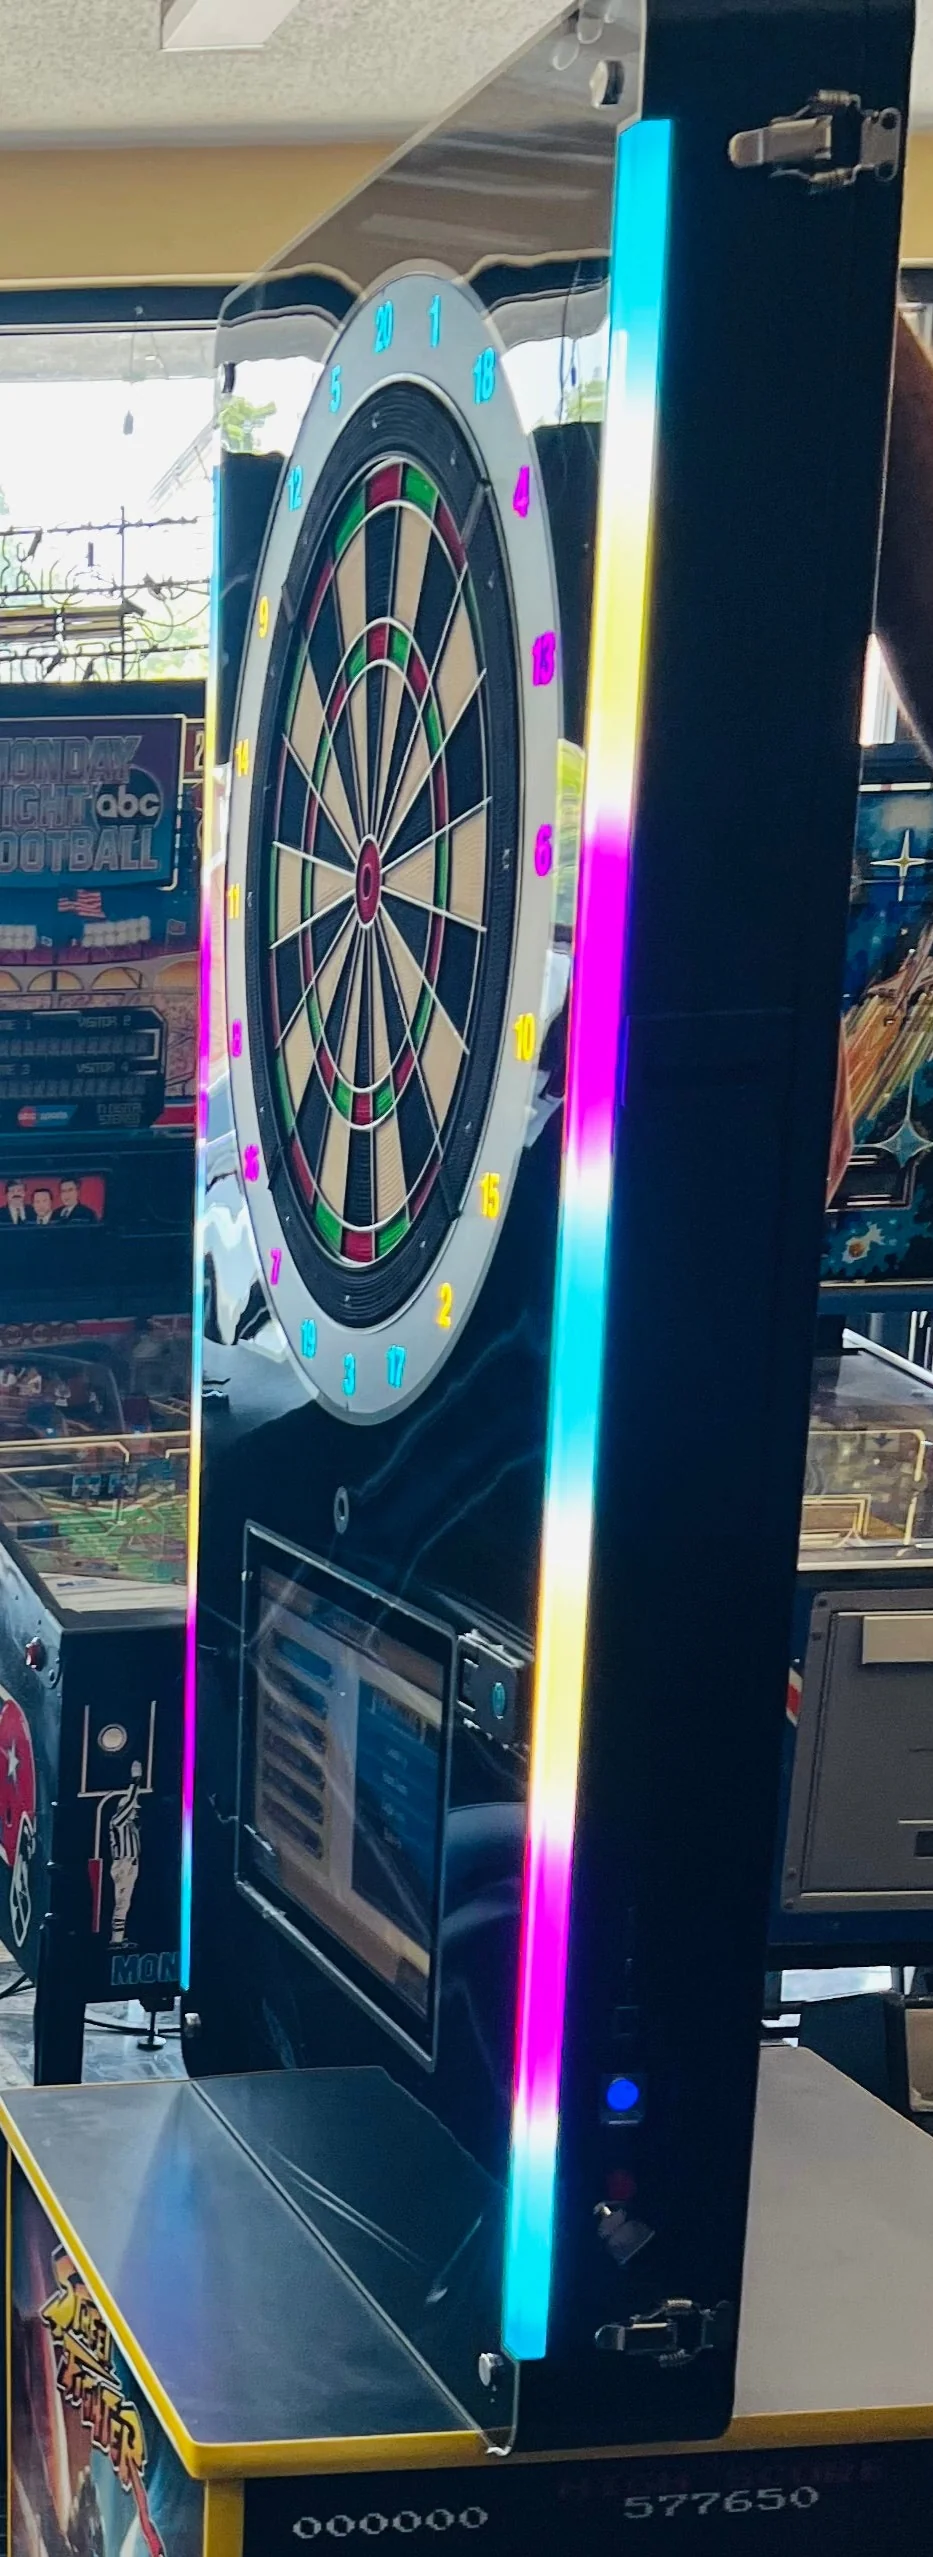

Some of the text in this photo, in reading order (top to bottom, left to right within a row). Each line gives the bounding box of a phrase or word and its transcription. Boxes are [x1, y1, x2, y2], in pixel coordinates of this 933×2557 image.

[373, 300, 395, 354] 20
[428, 294, 442, 349] 1
[329, 364, 343, 414] 5
[472, 346, 497, 405] 18
[286, 465, 304, 512] 12
[512, 465, 531, 519] 4
[258, 596, 269, 638] 9
[234, 738, 250, 777] 14
[96, 785, 161, 818] abc
[533, 822, 553, 878] 6
[227, 883, 241, 919] 11
[514, 1012, 537, 1063] 10
[479, 1172, 501, 1220] 15
[270, 1247, 281, 1285] 7
[437, 1282, 453, 1329] 2
[300, 1318, 318, 1360] 19
[341, 1352, 357, 1398] 3
[385, 1343, 408, 1391] 17
[111, 1952, 180, 1985] MON
[623, 2485, 819, 2519] 577650
